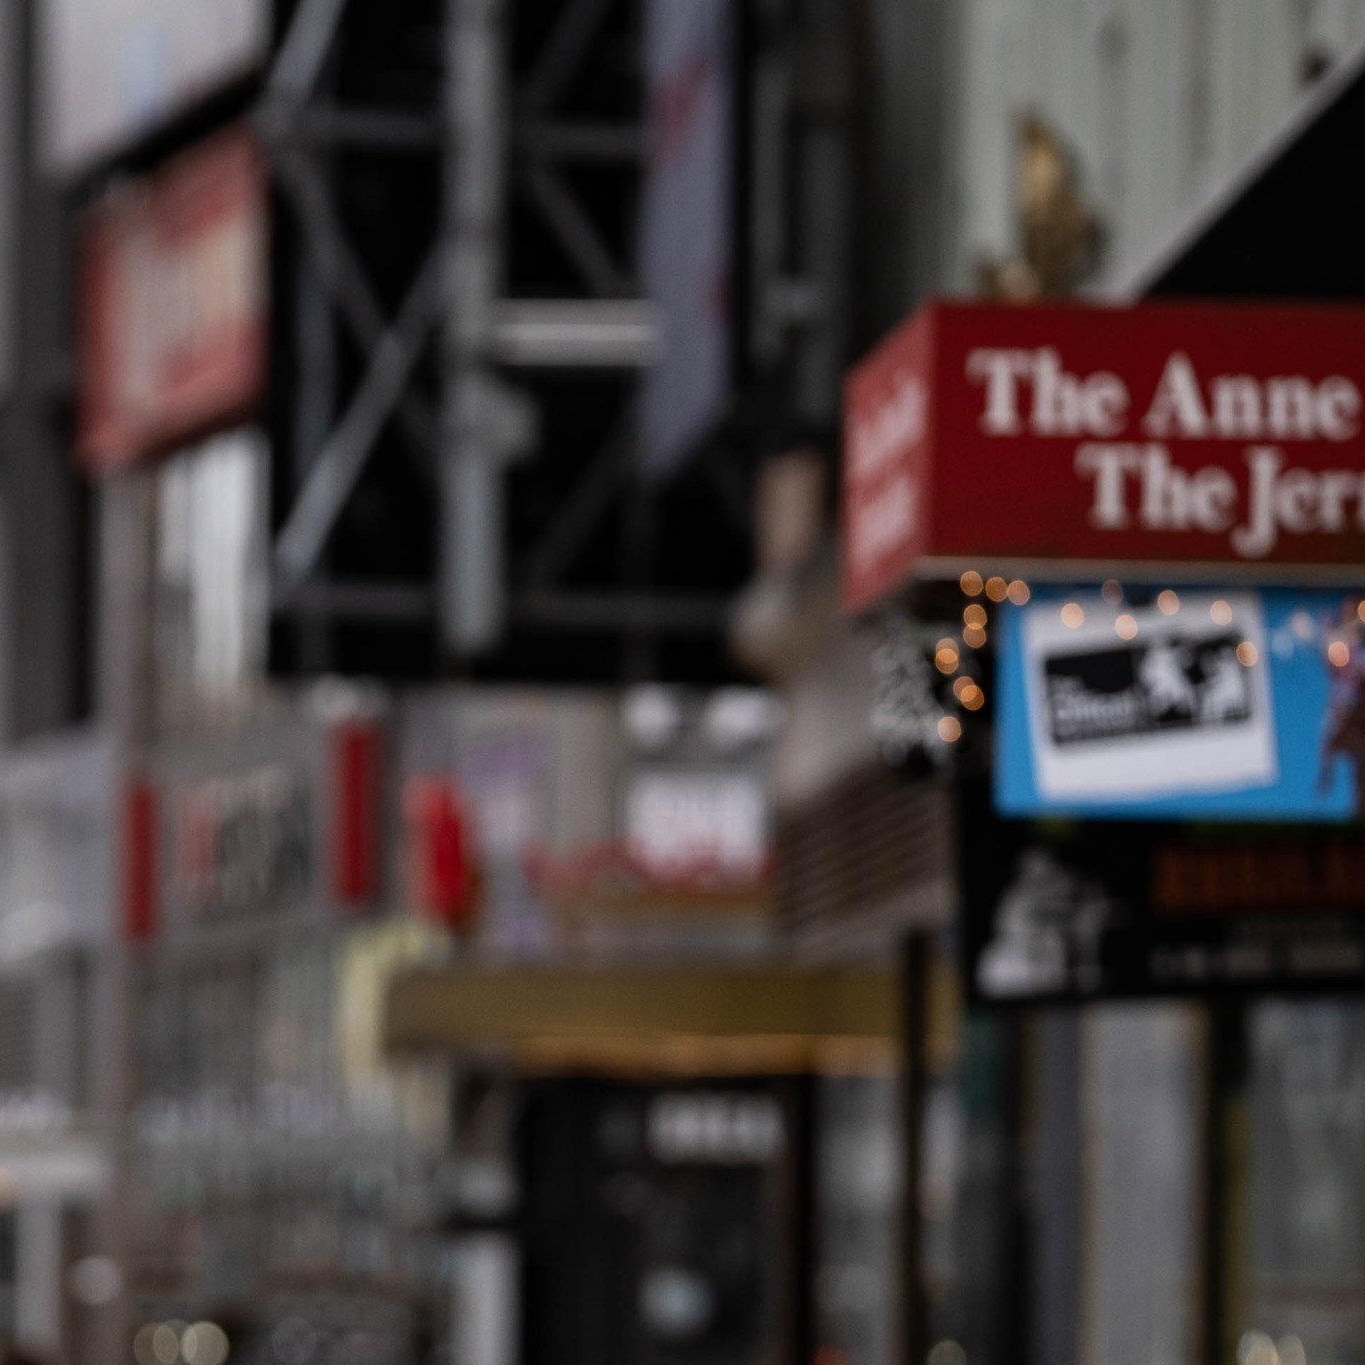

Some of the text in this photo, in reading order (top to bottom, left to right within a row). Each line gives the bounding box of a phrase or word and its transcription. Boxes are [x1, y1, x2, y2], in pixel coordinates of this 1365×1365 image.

[966, 345, 1364, 442] The Anne
[1074, 441, 1365, 558] The Jer
